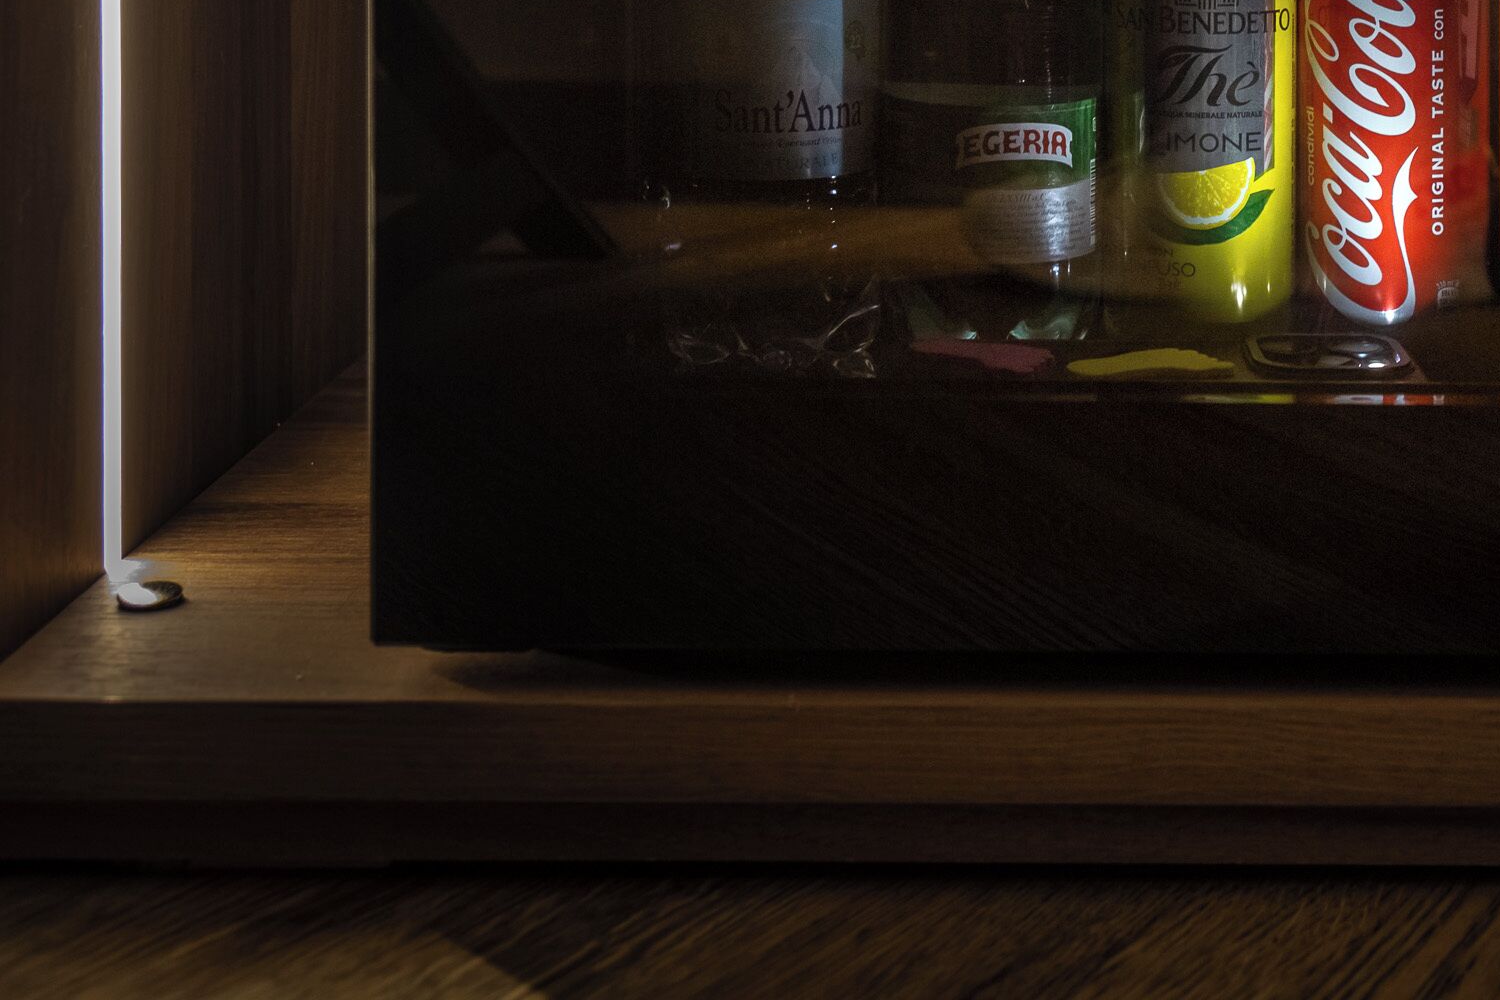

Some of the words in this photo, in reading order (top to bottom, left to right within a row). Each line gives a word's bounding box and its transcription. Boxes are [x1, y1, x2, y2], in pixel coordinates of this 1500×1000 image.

[1159, 7, 1291, 34] BENEDETTO
[1434, 8, 1445, 40] con
[1156, 44, 1261, 107] Thè
[1432, 49, 1445, 120] TASTE
[714, 89, 862, 134] Sant'Anna
[1185, 111, 1225, 119] MINERALE
[1227, 110, 1263, 119] NATURALE
[963, 129, 1068, 159] EGERIA
[1306, 105, 1316, 187] condividi
[1432, 127, 1445, 236] ORIGINAL
